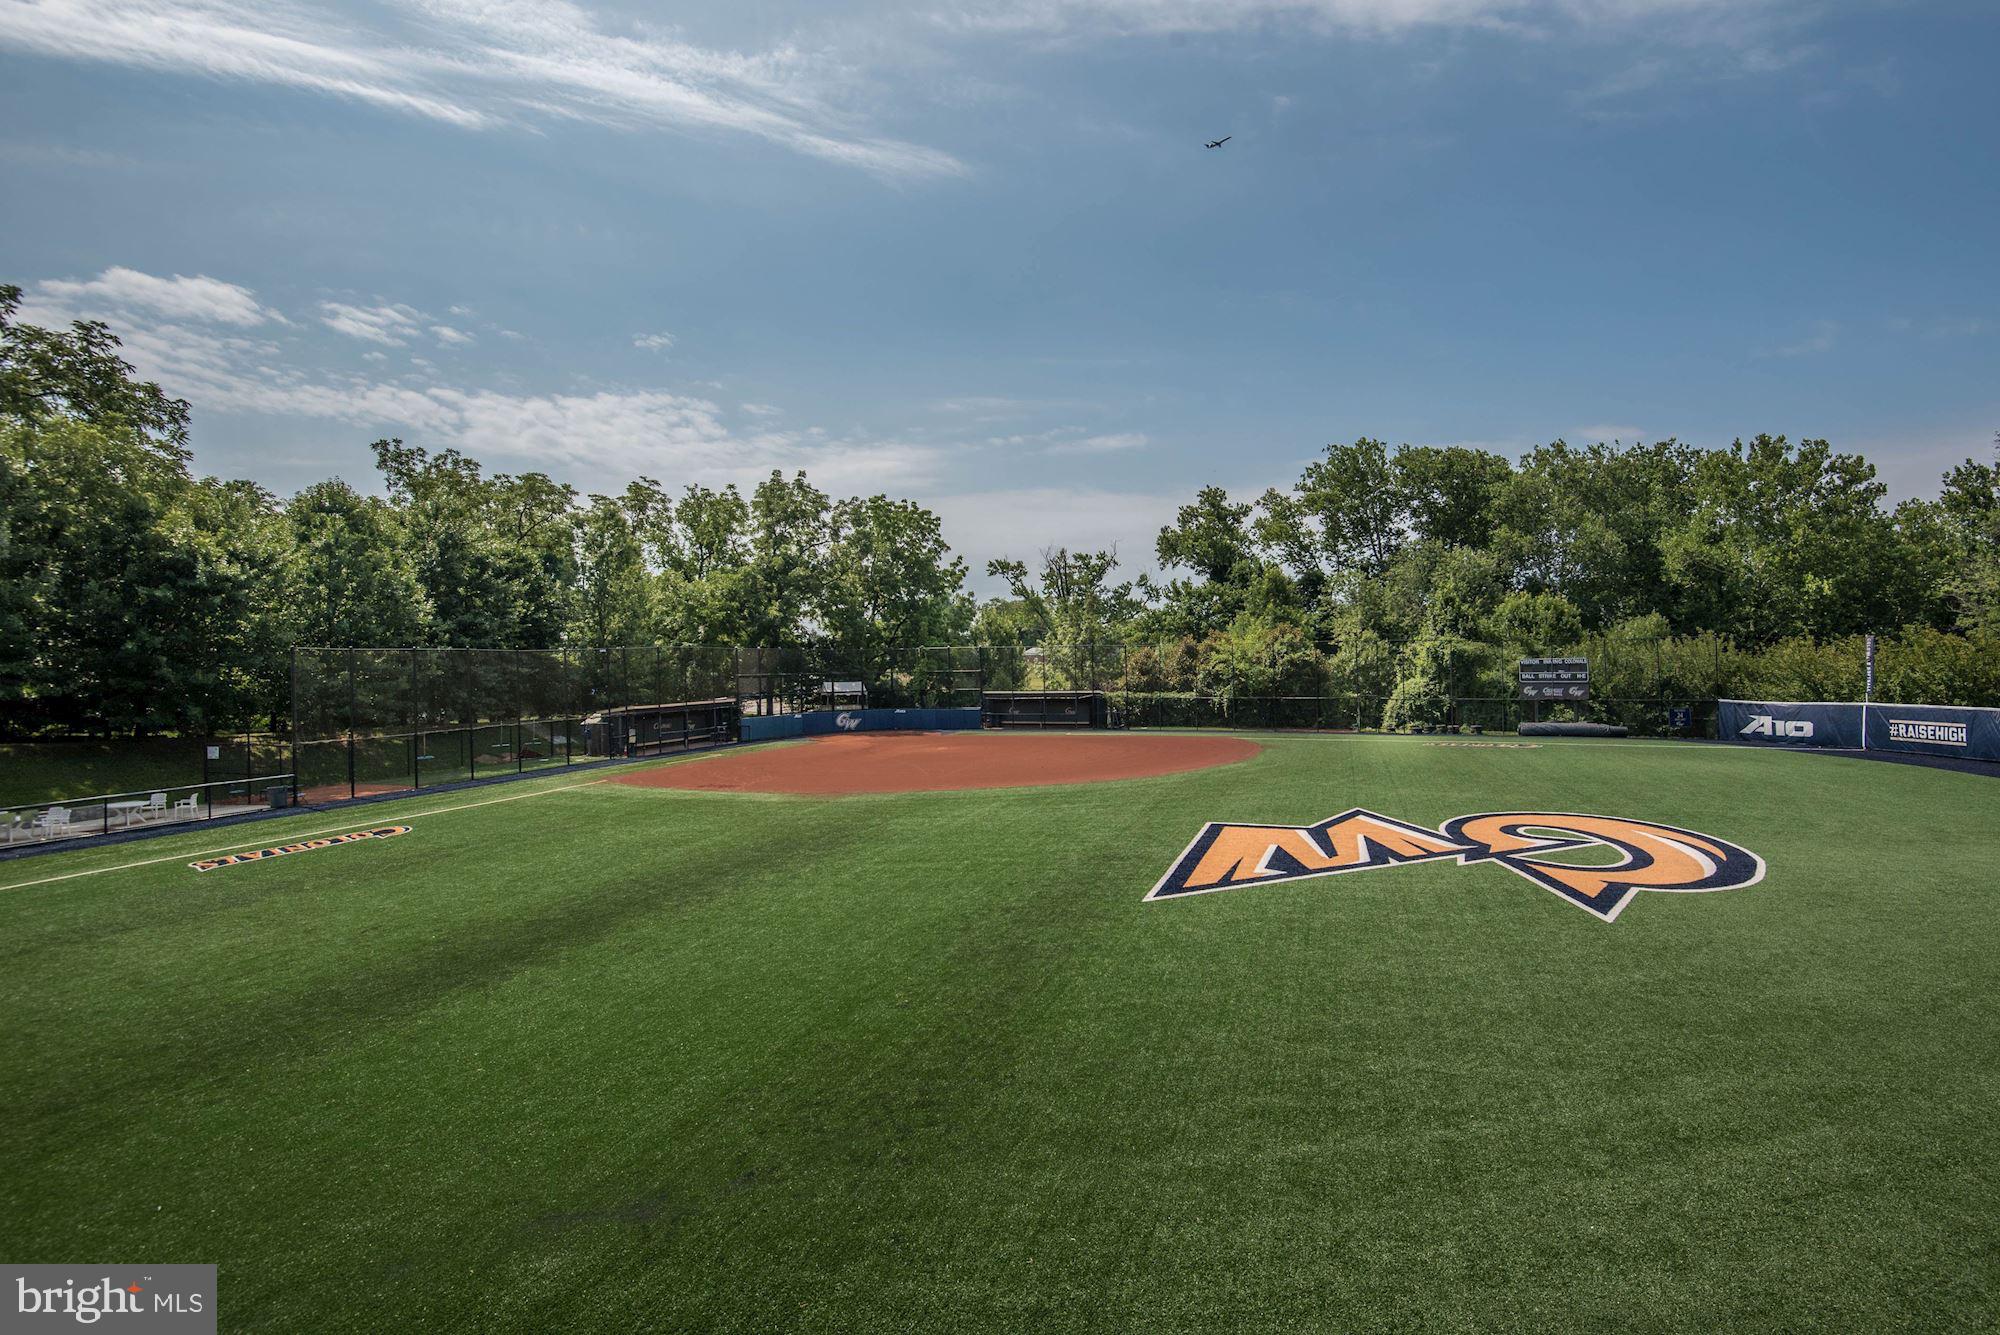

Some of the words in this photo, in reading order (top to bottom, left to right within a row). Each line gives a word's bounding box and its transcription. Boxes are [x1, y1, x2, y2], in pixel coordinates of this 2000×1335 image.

[836, 712, 862, 731] GW
[1739, 715, 1814, 738] A10
[1889, 722, 1968, 742] #RAISEHIGH
